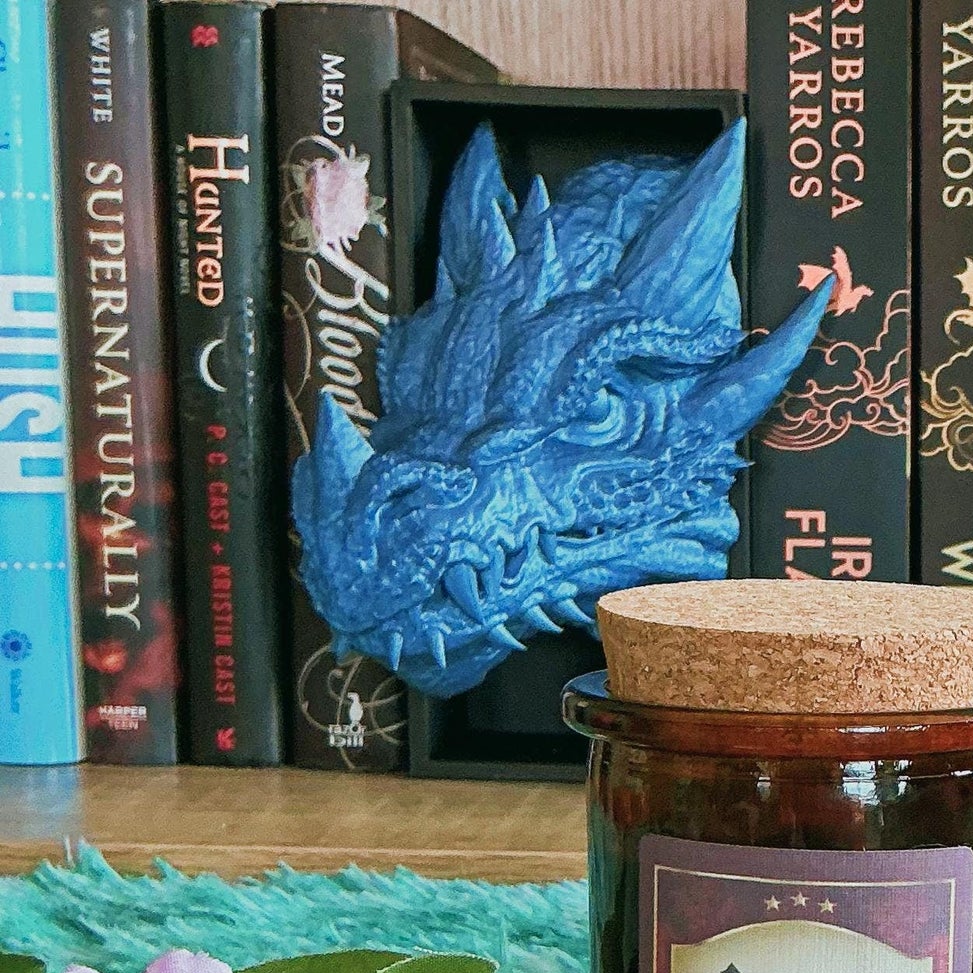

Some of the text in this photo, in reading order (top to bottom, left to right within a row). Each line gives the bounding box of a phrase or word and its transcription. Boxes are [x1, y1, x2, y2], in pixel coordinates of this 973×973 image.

[89, 27, 113, 123] WHITE
[319, 51, 346, 137] MEAD
[788, 6, 823, 198] YARROS
[830, 0, 865, 219] REBECCA
[304, 245, 391, 437] Blood
[84, 161, 141, 631] SUPERNATURALLY
[208, 480, 231, 532] CAST
[831, 536, 873, 580] IR
[210, 564, 234, 648] KRISTIN
[99, 705, 147, 716] HARPER
[214, 654, 237, 705] CAST
